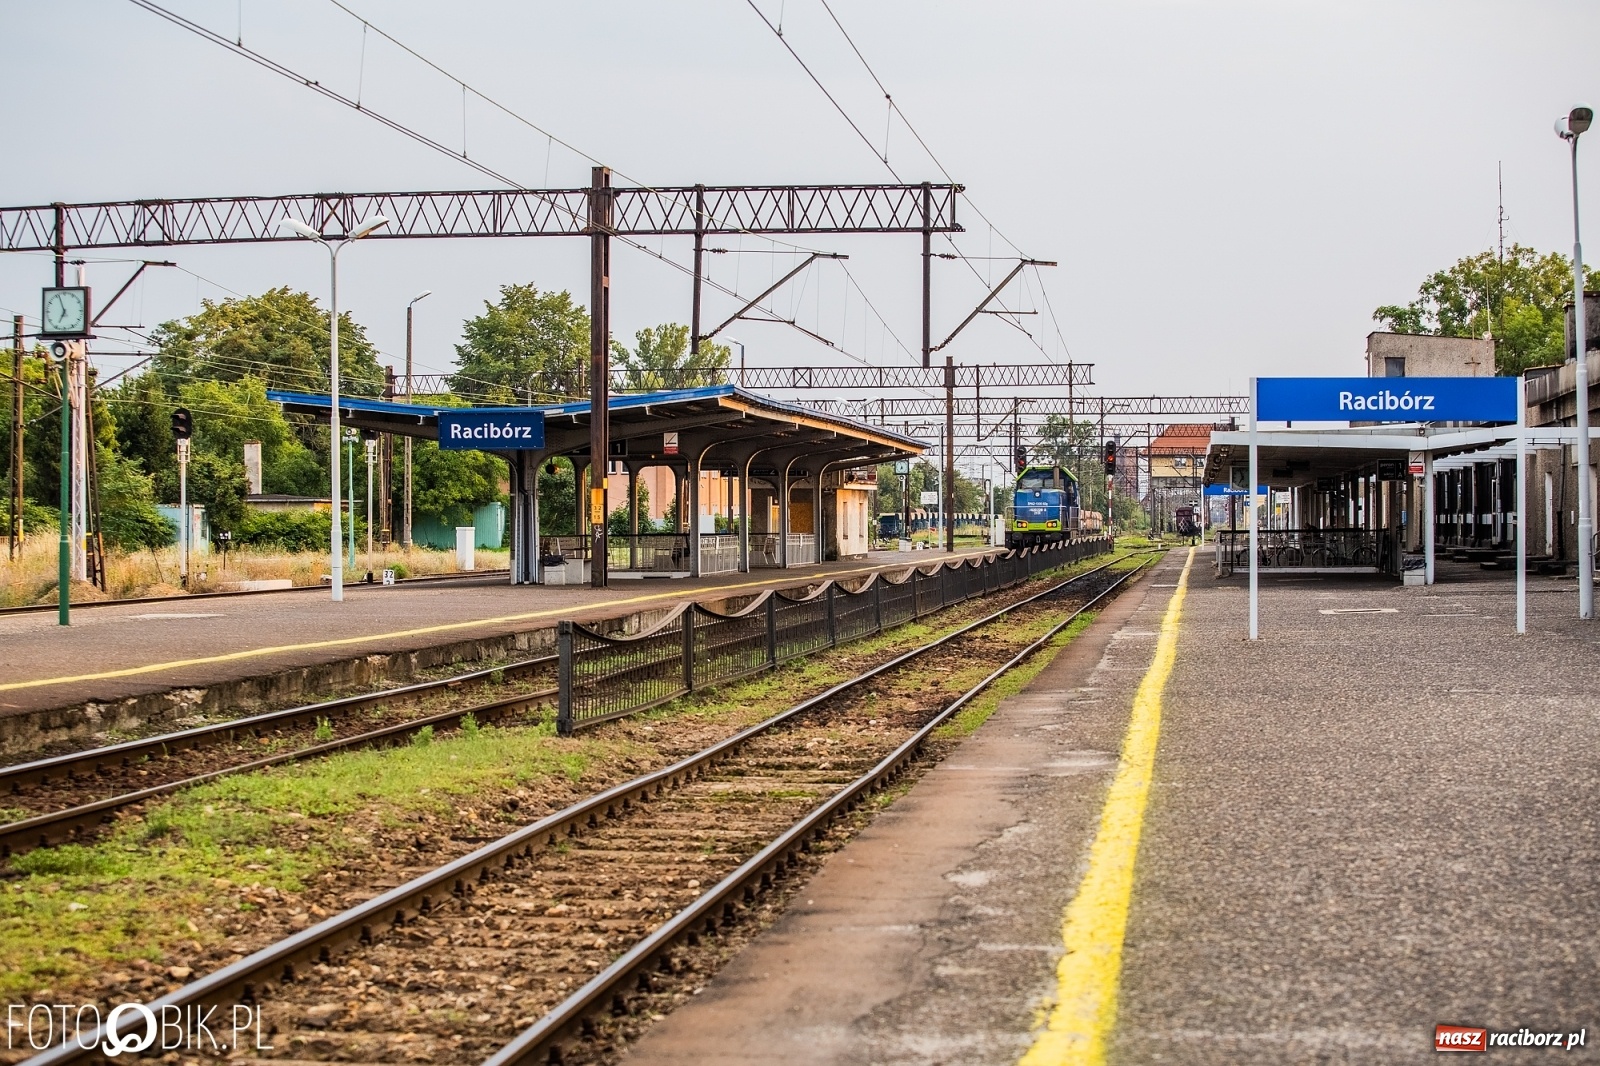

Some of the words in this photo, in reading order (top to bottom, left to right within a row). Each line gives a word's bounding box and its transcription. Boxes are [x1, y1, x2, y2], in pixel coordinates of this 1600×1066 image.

[1339, 390, 1435, 410] Racibórz
[450, 422, 532, 439] Racibórz
[384, 570, 394, 578] 32
